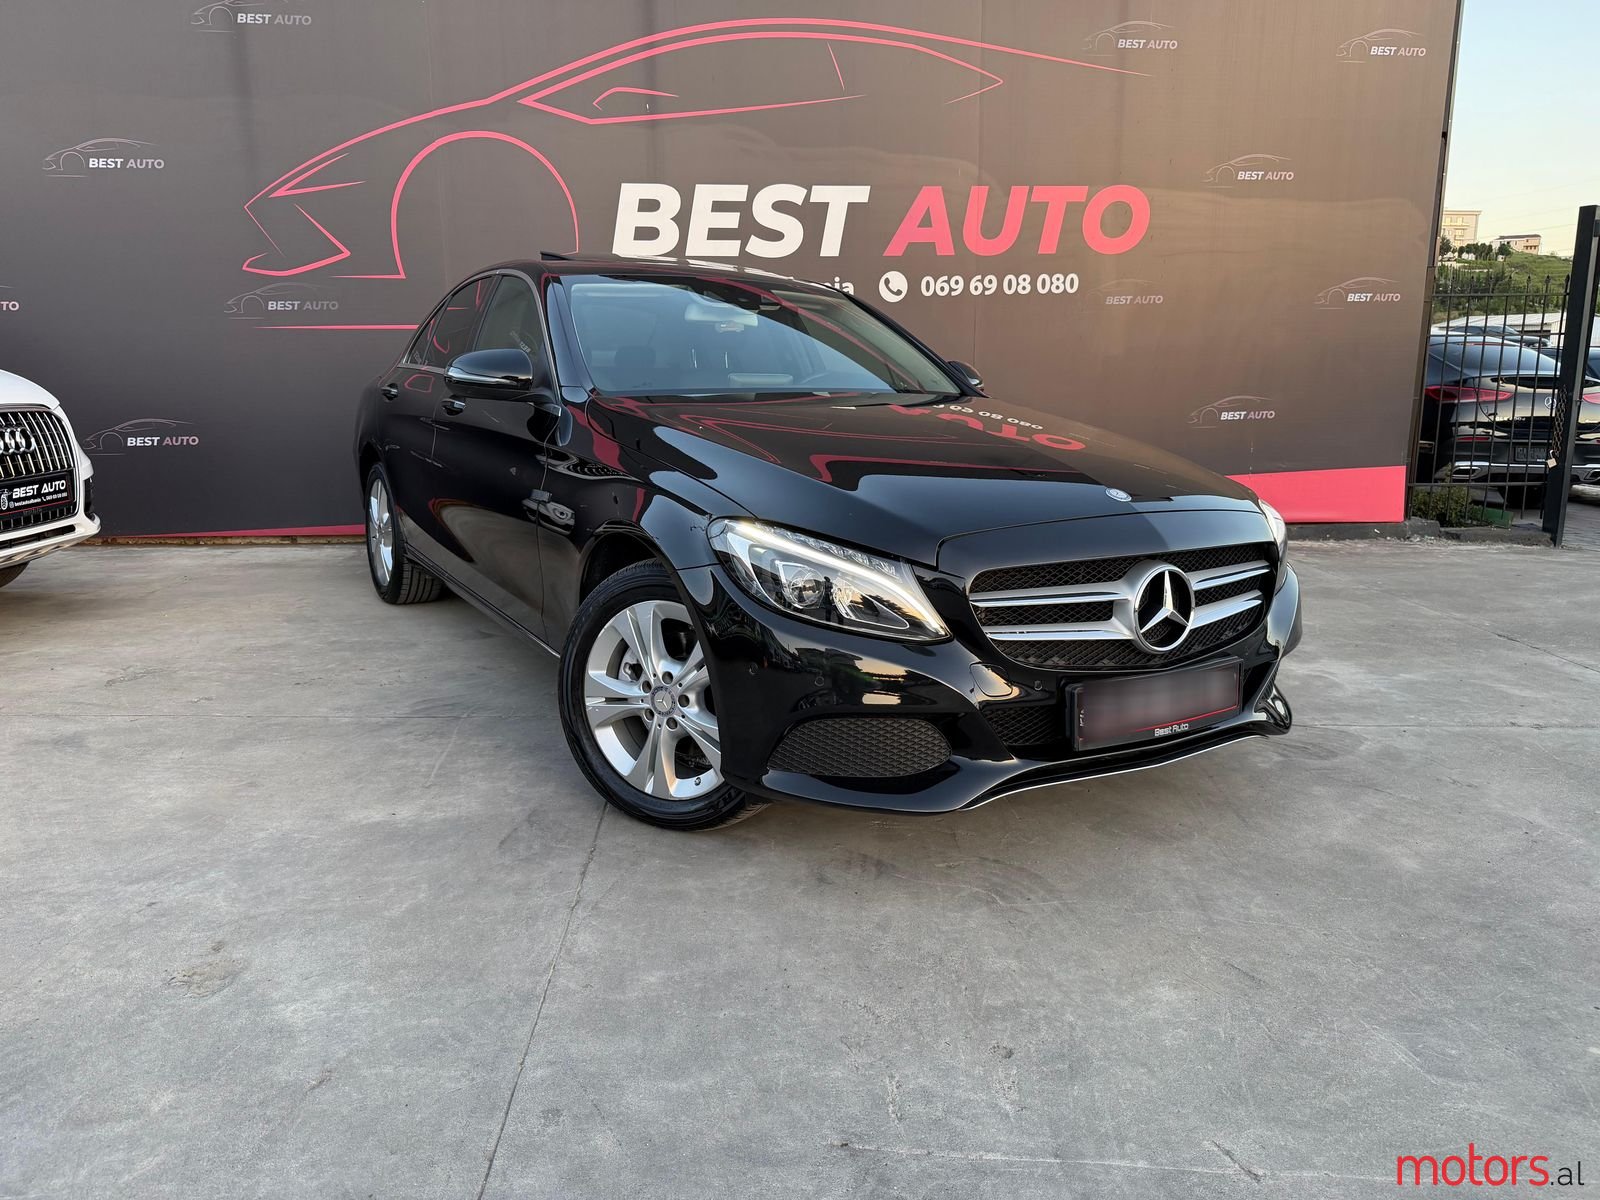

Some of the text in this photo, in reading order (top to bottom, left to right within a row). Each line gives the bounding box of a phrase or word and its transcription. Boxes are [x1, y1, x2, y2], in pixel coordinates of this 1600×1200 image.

[237, 13, 311, 25] BEST AUTO
[1117, 38, 1178, 50] BEST AUTO
[1370, 46, 1427, 56] BEST AUTO
[88, 158, 164, 169] BEST AUTO
[1237, 171, 1294, 181] BEST AUTO
[612, 183, 1151, 258] BEST AUTO
[920, 273, 1080, 297] 069 69 08 080
[1106, 295, 1163, 305] BEST AUTO
[1347, 293, 1400, 302] BEST AUTO
[268, 301, 339, 311] BEST AUTO
[1221, 411, 1275, 420] BEST AUTO
[127, 436, 198, 446] BEST AUTO
[12, 484, 40, 499] BEST
[41, 480, 66, 494] AUTO
[1154, 723, 1189, 737] Best Auto
